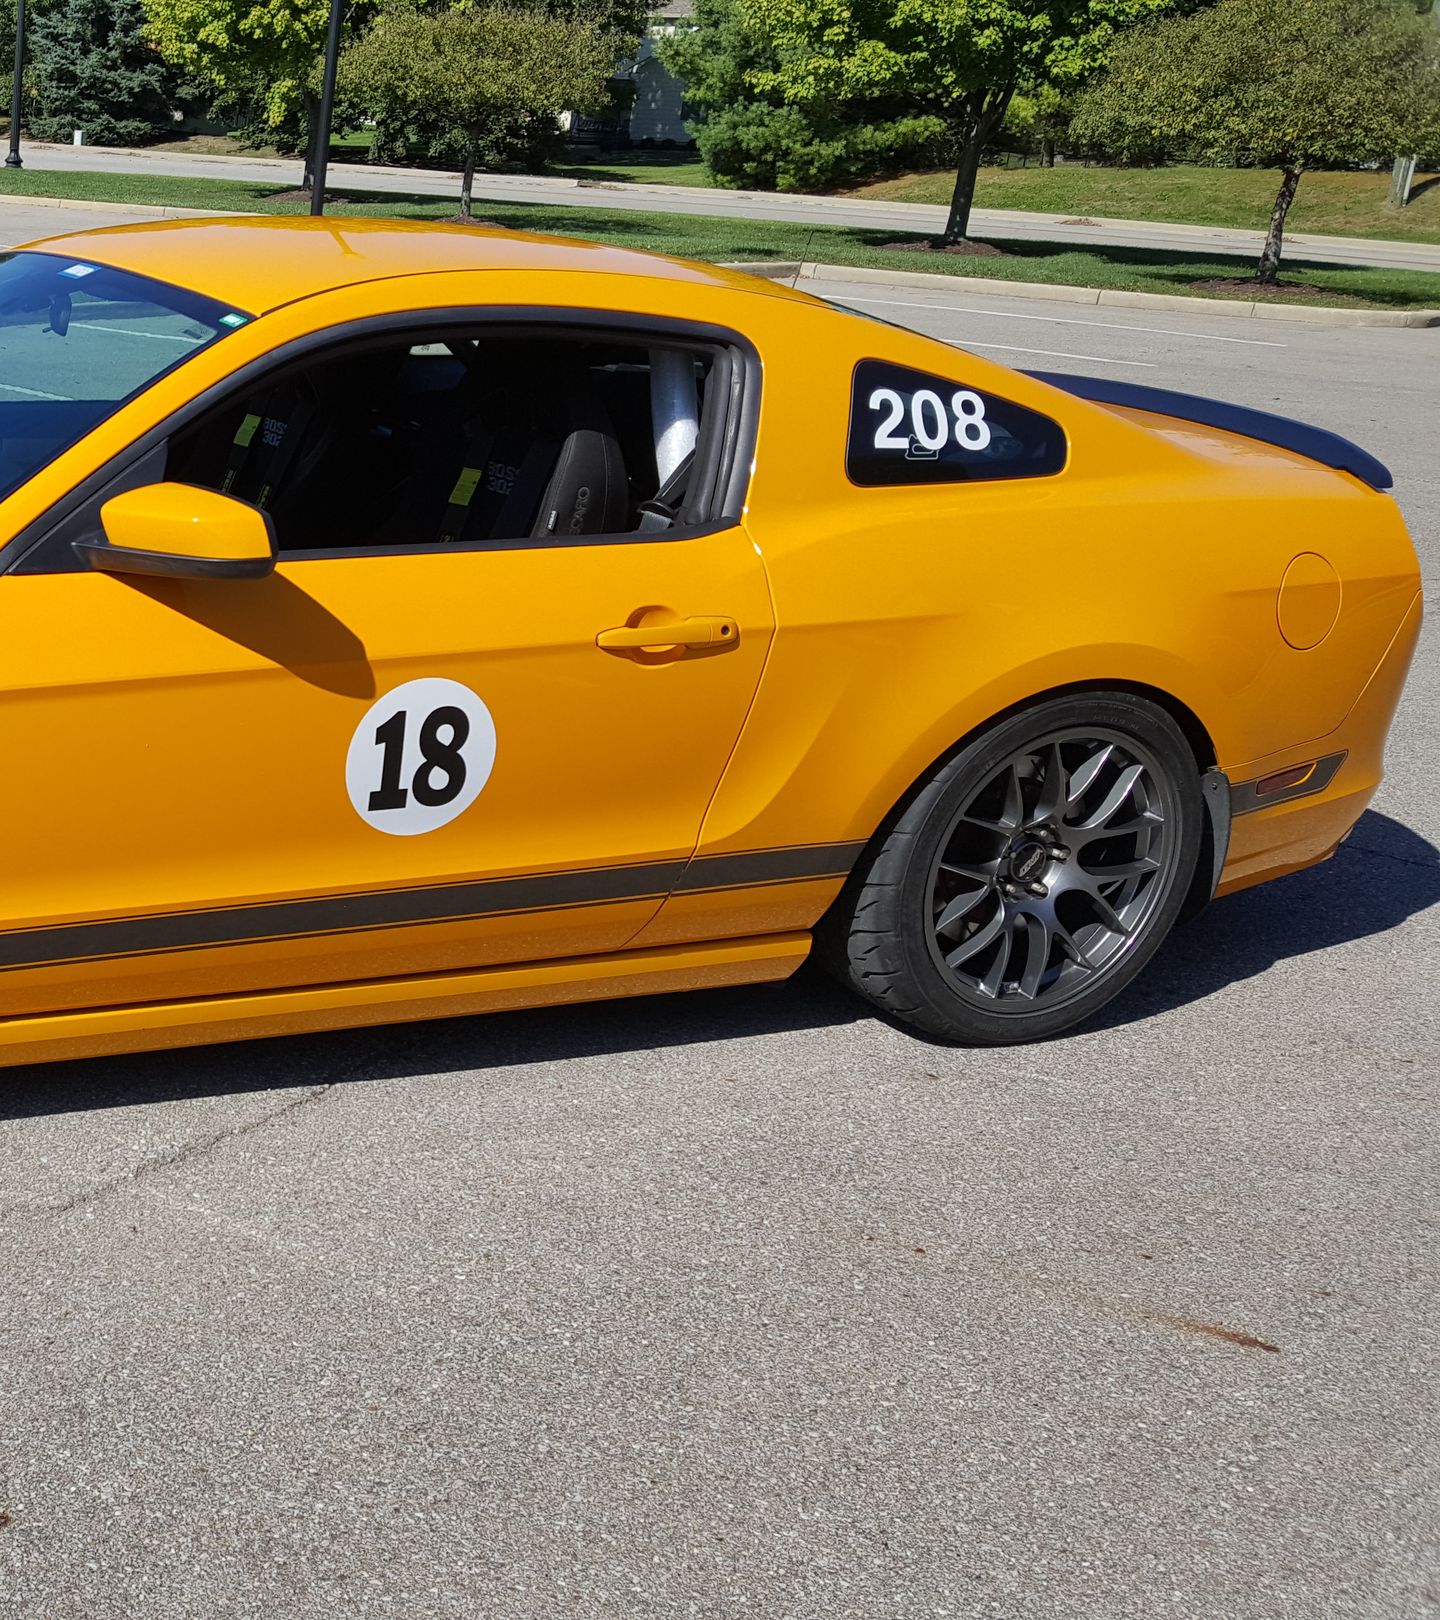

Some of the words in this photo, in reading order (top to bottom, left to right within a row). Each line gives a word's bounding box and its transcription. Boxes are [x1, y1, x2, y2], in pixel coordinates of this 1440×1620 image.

[869, 388, 991, 451] 208
[568, 486, 591, 536] ECARO
[368, 705, 470, 811] 18
